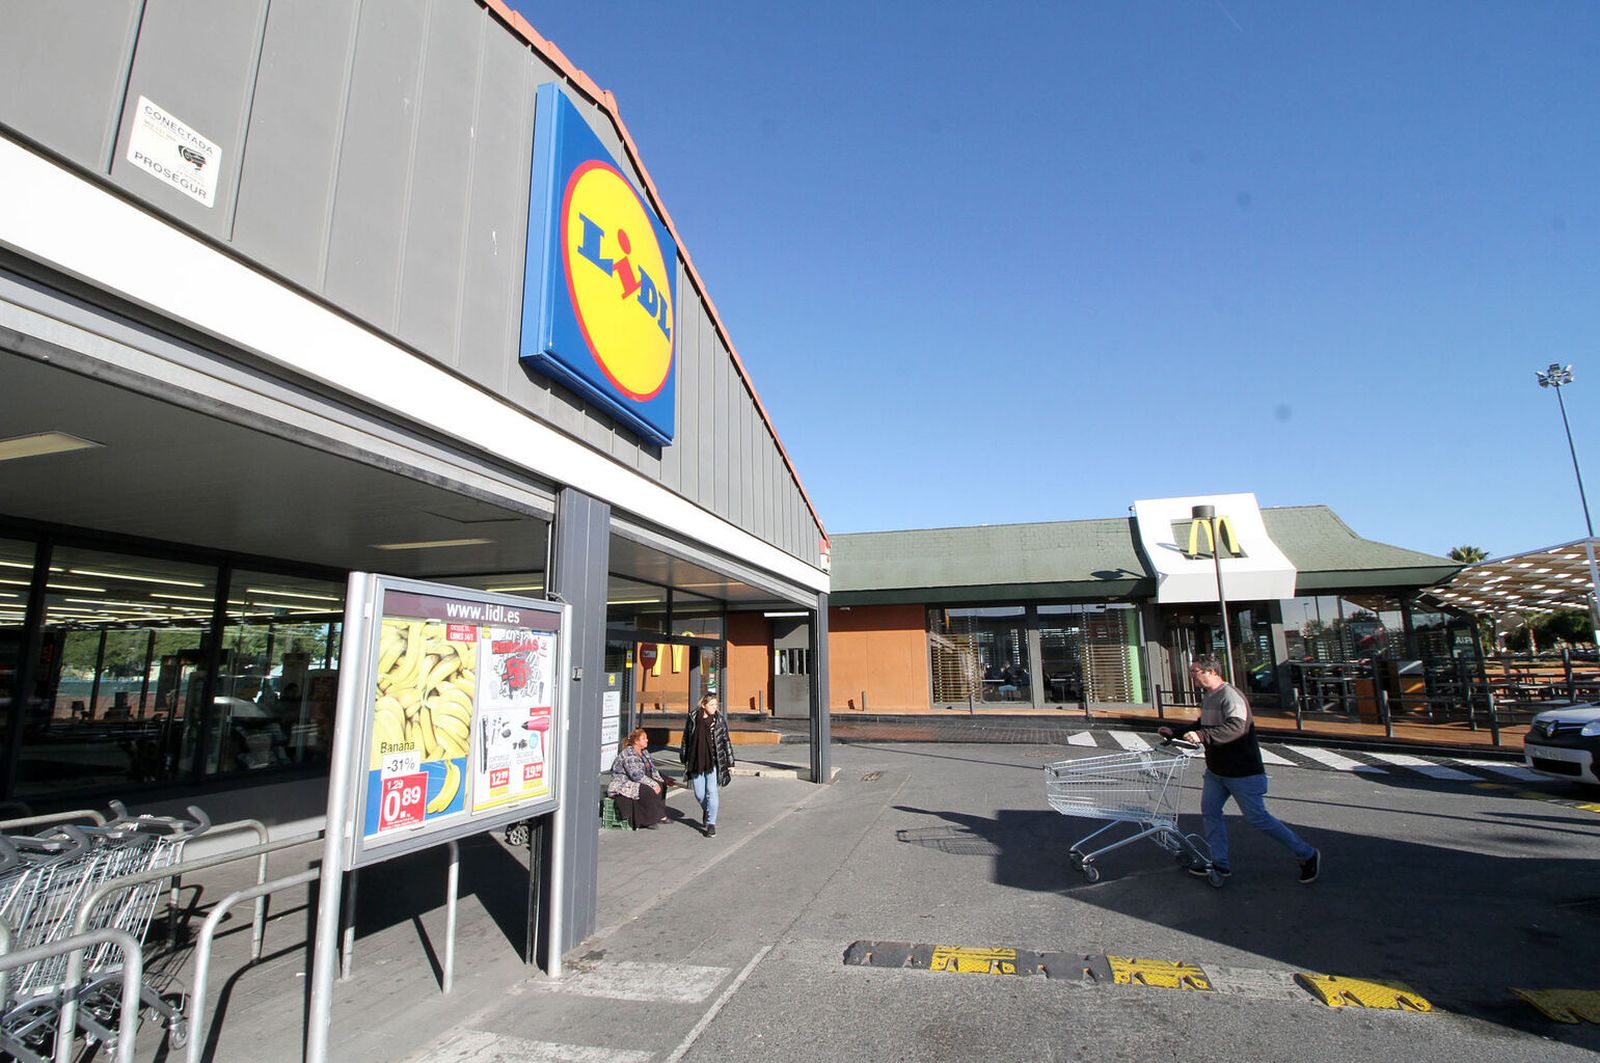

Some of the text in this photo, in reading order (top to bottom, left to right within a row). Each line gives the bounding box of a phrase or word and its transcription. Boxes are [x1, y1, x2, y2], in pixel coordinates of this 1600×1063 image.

[144, 105, 213, 155] CONECTADA
[134, 151, 208, 199] PROSEGUR
[446, 603, 520, 623] www.lidl.es
[380, 741, 415, 753] Banana
[387, 757, 415, 772] -31%
